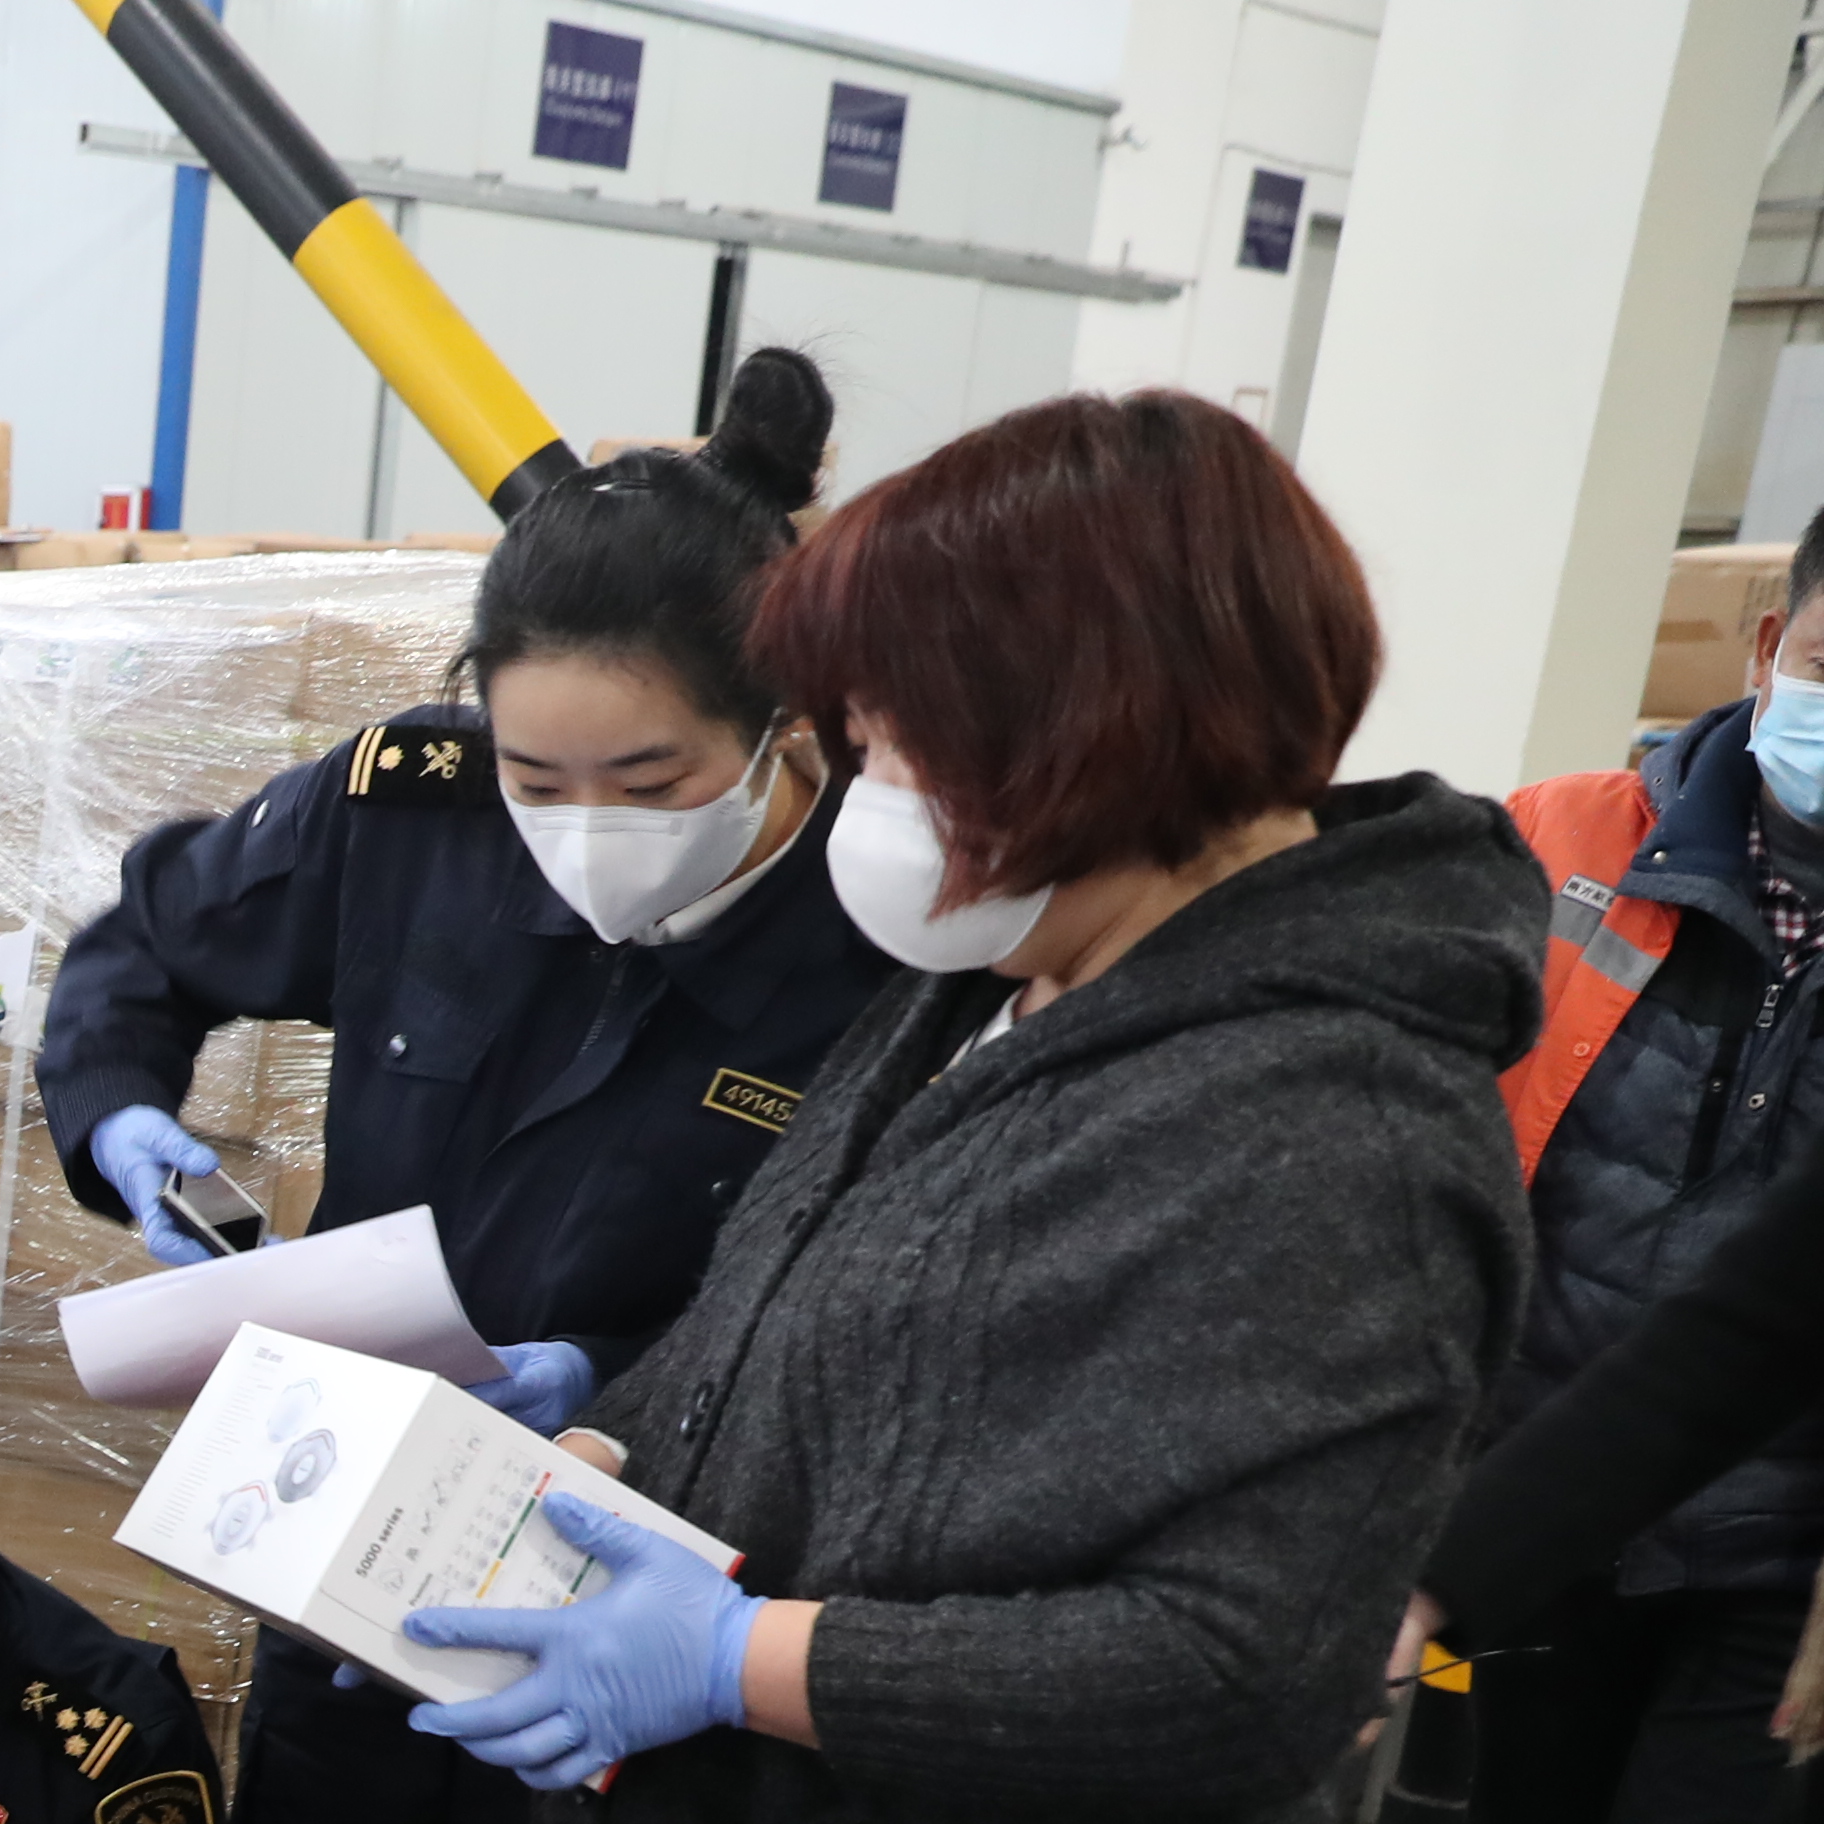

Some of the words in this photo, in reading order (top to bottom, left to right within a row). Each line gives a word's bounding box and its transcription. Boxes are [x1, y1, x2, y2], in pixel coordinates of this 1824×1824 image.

[723, 1084, 795, 1122] 49145
[355, 1543, 382, 1578] 5000
[379, 1507, 404, 1543] series
